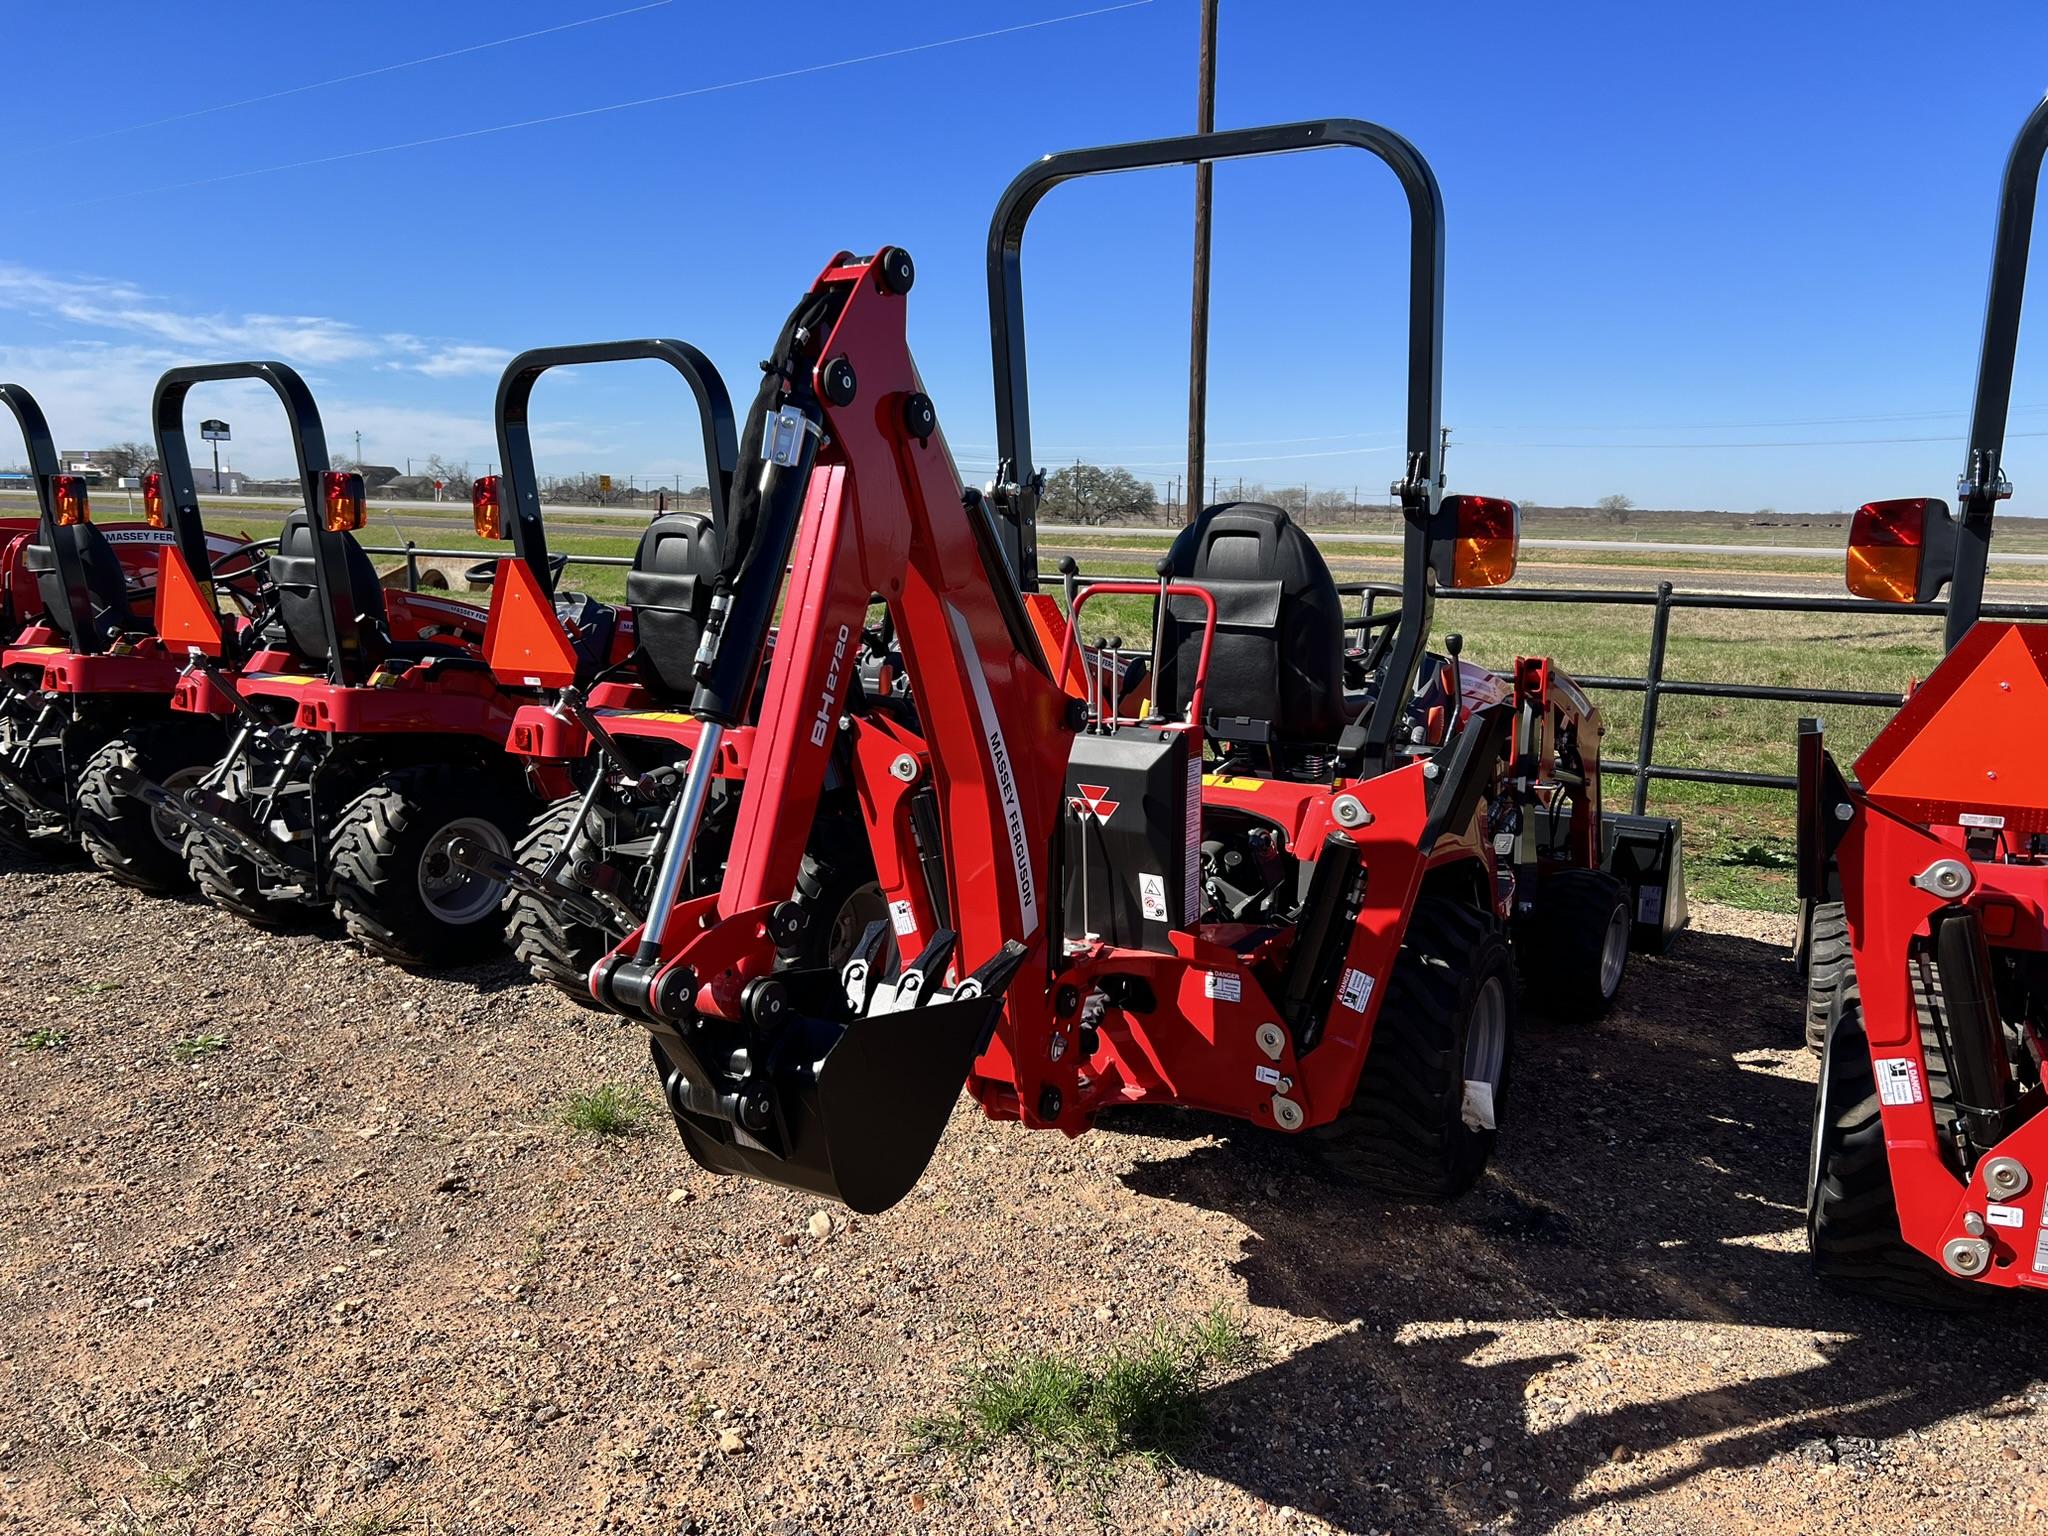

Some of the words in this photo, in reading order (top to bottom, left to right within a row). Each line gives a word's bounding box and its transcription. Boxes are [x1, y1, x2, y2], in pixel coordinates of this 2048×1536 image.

[106, 532, 150, 541] MASSEY
[451, 606, 475, 616] MASSEY
[990, 731, 1015, 805] MASSEY
[1009, 810, 1032, 907] FERGUSON
[1214, 970, 1240, 980] DANGER
[1339, 967, 1352, 994] DANGER
[1908, 1069, 1924, 1102] DANGER
